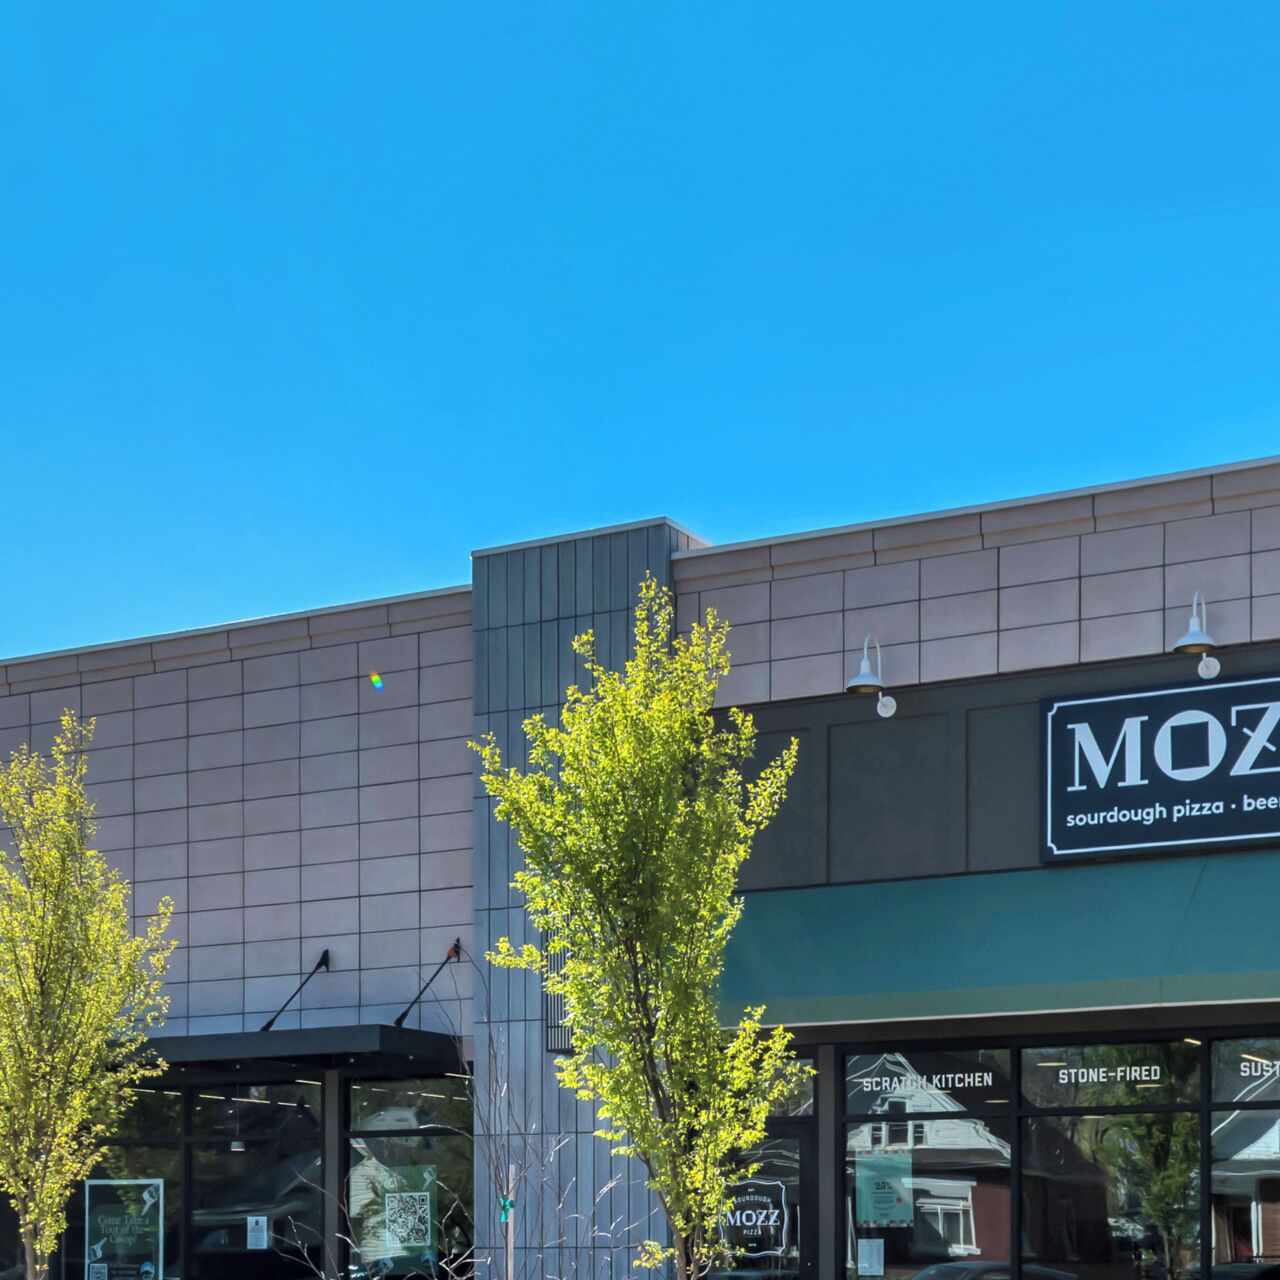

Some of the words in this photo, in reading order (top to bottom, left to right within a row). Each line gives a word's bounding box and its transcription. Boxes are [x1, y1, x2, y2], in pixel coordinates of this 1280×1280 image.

[1066, 801, 1167, 828] sourdough
[1172, 798, 1225, 823] pizza
[863, 1075, 928, 1092] SCRATCH
[932, 1071, 993, 1089] KITCHEN
[1058, 1064, 1161, 1085] STONE-FIRED
[726, 1209, 780, 1226] MOZZ
